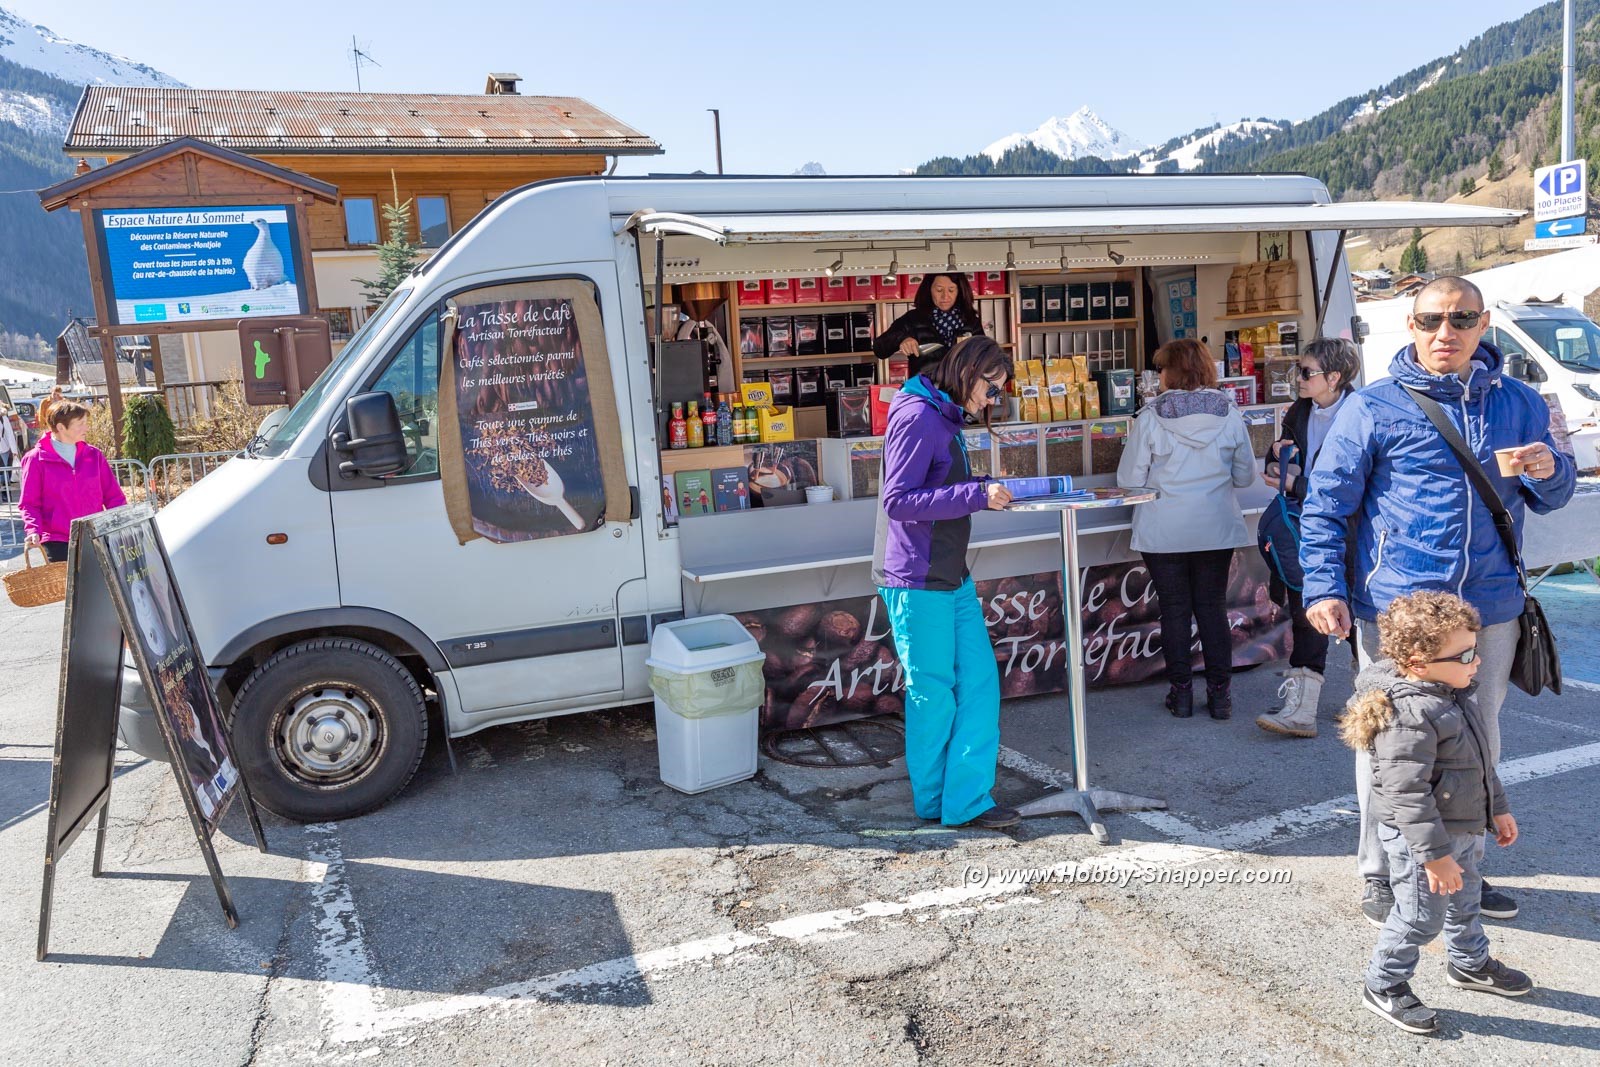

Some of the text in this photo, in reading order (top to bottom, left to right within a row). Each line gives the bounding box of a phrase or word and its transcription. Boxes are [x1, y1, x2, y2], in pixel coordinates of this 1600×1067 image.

[1560, 167, 1577, 194] P
[1537, 195, 1582, 209] 100 Places
[1558, 203, 1582, 213] GRATUIT
[108, 212, 245, 227] Espace Nature Au Sommet
[130, 232, 165, 241] Découvrez
[172, 231, 198, 239] Réserve
[199, 230, 228, 239] Naturelle
[140, 241, 222, 251] des Contamines-Montjoie
[133, 261, 155, 269] Ouvert
[156, 260, 170, 268] tous
[181, 259, 197, 268] jours
[206, 258, 215, 266] 9h
[221, 257, 233, 265] 19h
[132, 271, 144, 280] (au
[145, 268, 197, 279] rez-de-chaussée
[197, 268, 206, 276] de
[213, 267, 236, 276] Mairie)
[457, 302, 573, 329] La Tasse de Café
[467, 324, 565, 343] Artisan Torréfacteur
[459, 348, 575, 370] Cafés sélectionnés parmi
[462, 369, 566, 388] les meilleures variétés
[475, 409, 578, 431] Toute une gamme de
[469, 436, 492, 449] Thés
[526, 431, 548, 444] Thés
[549, 428, 576, 443] noirs
[578, 427, 588, 438] et
[491, 445, 574, 464] de Gelées de thés
[565, 597, 615, 617] vivid
[864, 596, 892, 642] L
[975, 589, 1048, 627] sse
[1120, 566, 1160, 608] Ca
[808, 658, 907, 706] Arti
